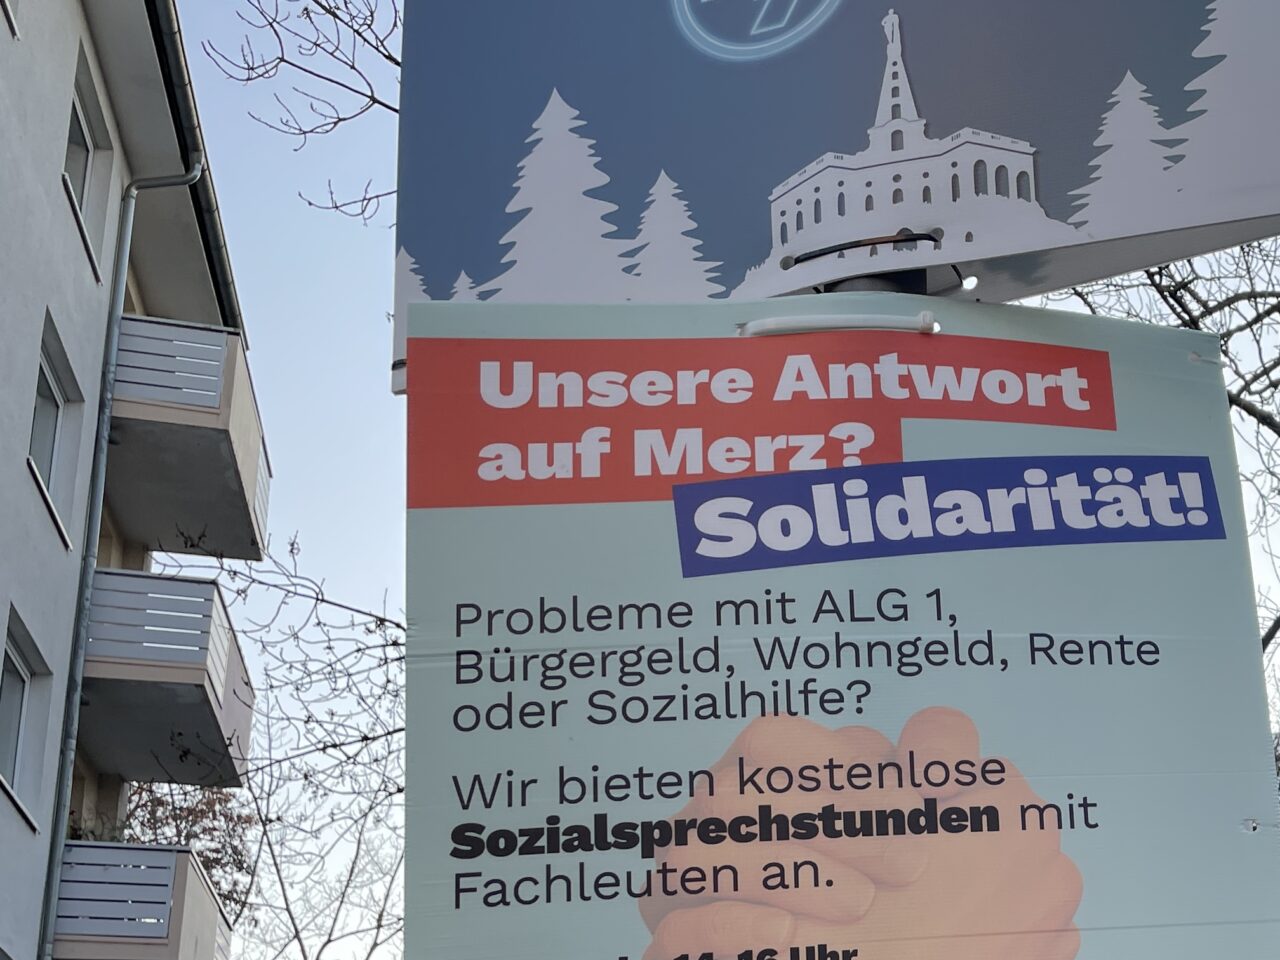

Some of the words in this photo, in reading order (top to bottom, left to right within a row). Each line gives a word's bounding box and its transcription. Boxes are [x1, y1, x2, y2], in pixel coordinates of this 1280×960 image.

[478, 358, 754, 409] Unsere
[772, 352, 1092, 412] Antwort
[477, 430, 611, 481] auf
[634, 422, 876, 476] Merz?
[694, 467, 1210, 559] Solidarität!
[455, 596, 693, 638] Probleme
[714, 589, 796, 627] mit
[812, 588, 908, 625] ALG
[926, 587, 958, 627] 1,
[455, 636, 735, 691] Bürgergeld,
[754, 630, 1008, 677] Wohngeld,
[1029, 632, 1160, 666] Rente
[453, 692, 566, 732] oder
[586, 680, 871, 727] Sozialhilfe?
[452, 769, 538, 810] Wir
[558, 762, 715, 805] bieten
[736, 750, 1006, 796] kostenlose
[449, 797, 1000, 860] Sozialsprechstunden
[1019, 793, 1099, 832] mit
[453, 857, 740, 909] Fachleuten
[761, 861, 834, 893] an.
